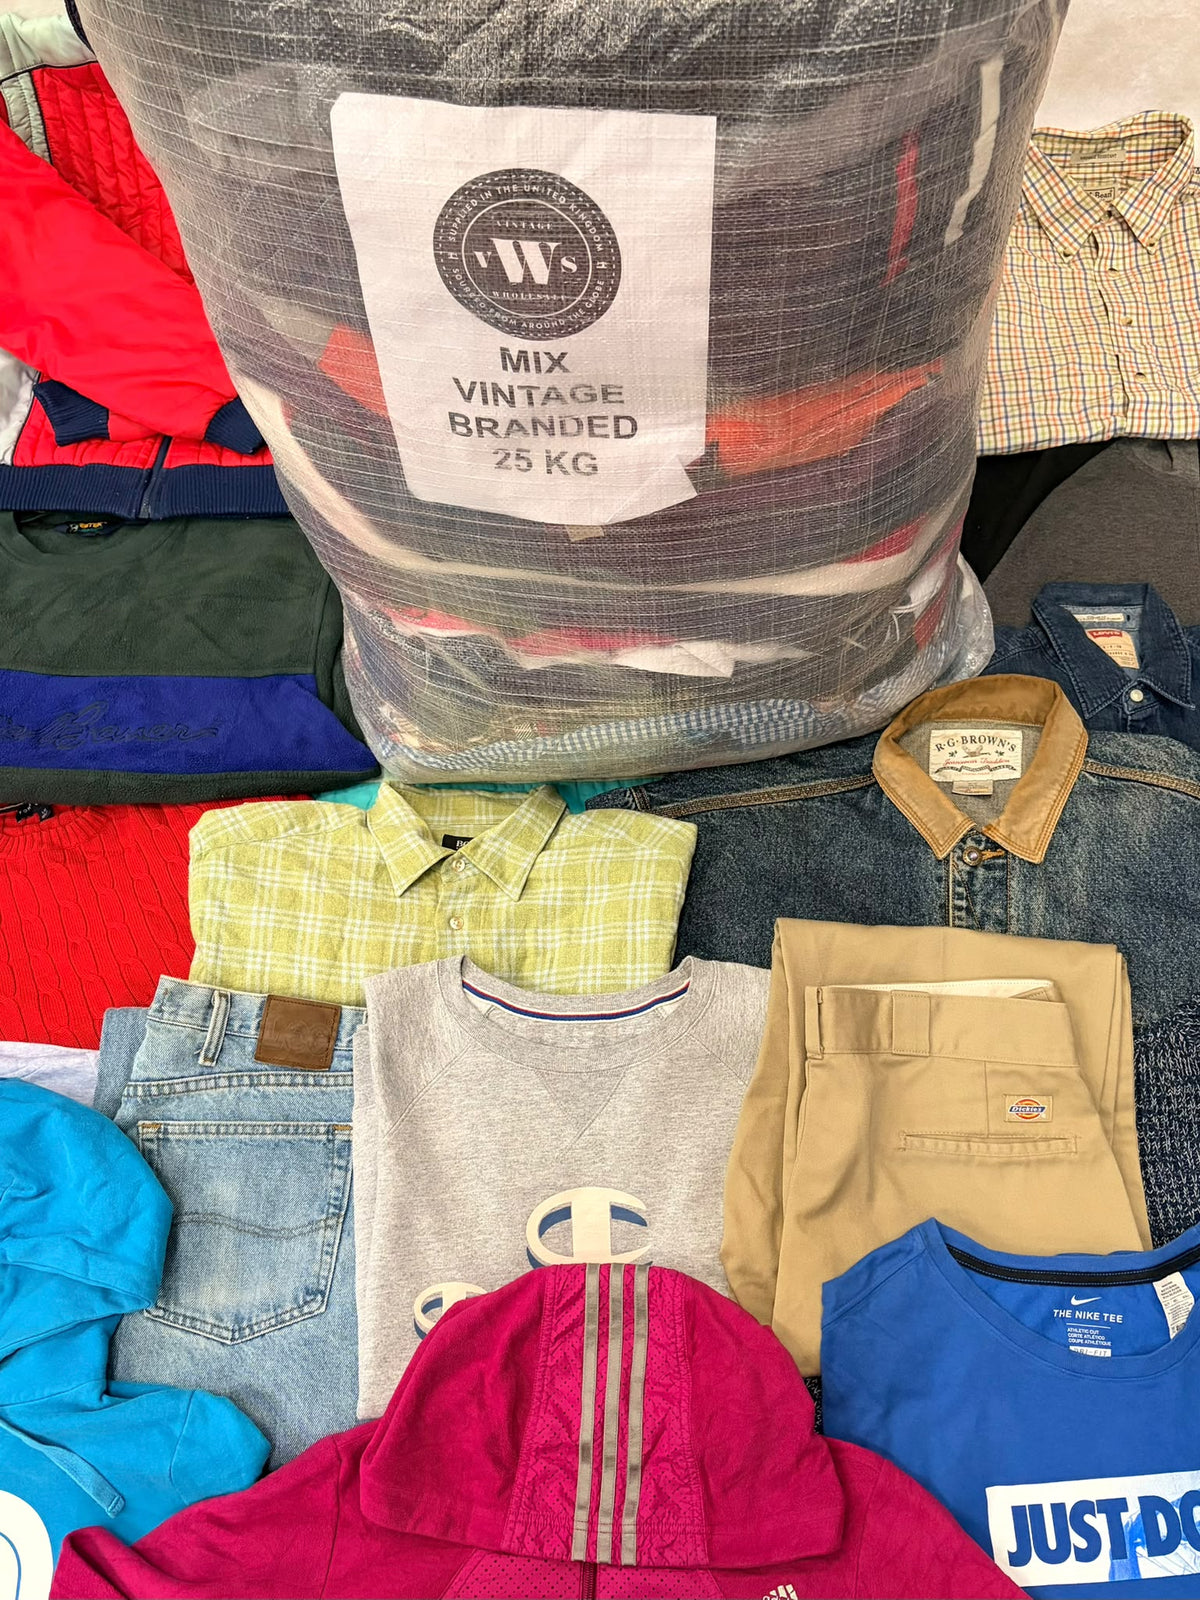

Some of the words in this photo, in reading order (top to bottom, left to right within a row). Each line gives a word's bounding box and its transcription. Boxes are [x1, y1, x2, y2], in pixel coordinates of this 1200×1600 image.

[448, 199, 477, 241] SUPPLIED
[480, 190, 492, 200] IN
[496, 184, 518, 194] THE
[523, 185, 566, 203] UNITED
[569, 203, 603, 252] KINGDOM
[521, 320, 565, 329] AROUND
[568, 308, 585, 321] THE
[585, 280, 604, 308] GLOBE
[499, 346, 571, 375] MIX
[452, 377, 625, 408] VINTAGE
[448, 411, 638, 439] BRANDED
[492, 448, 533, 472] 25
[545, 449, 598, 476] KG
[1053, 1309, 1072, 1318] THE
[1075, 1310, 1100, 1321] NIKE
[1103, 1313, 1123, 1323] TEE
[1007, 1496, 1129, 1568] JUST
